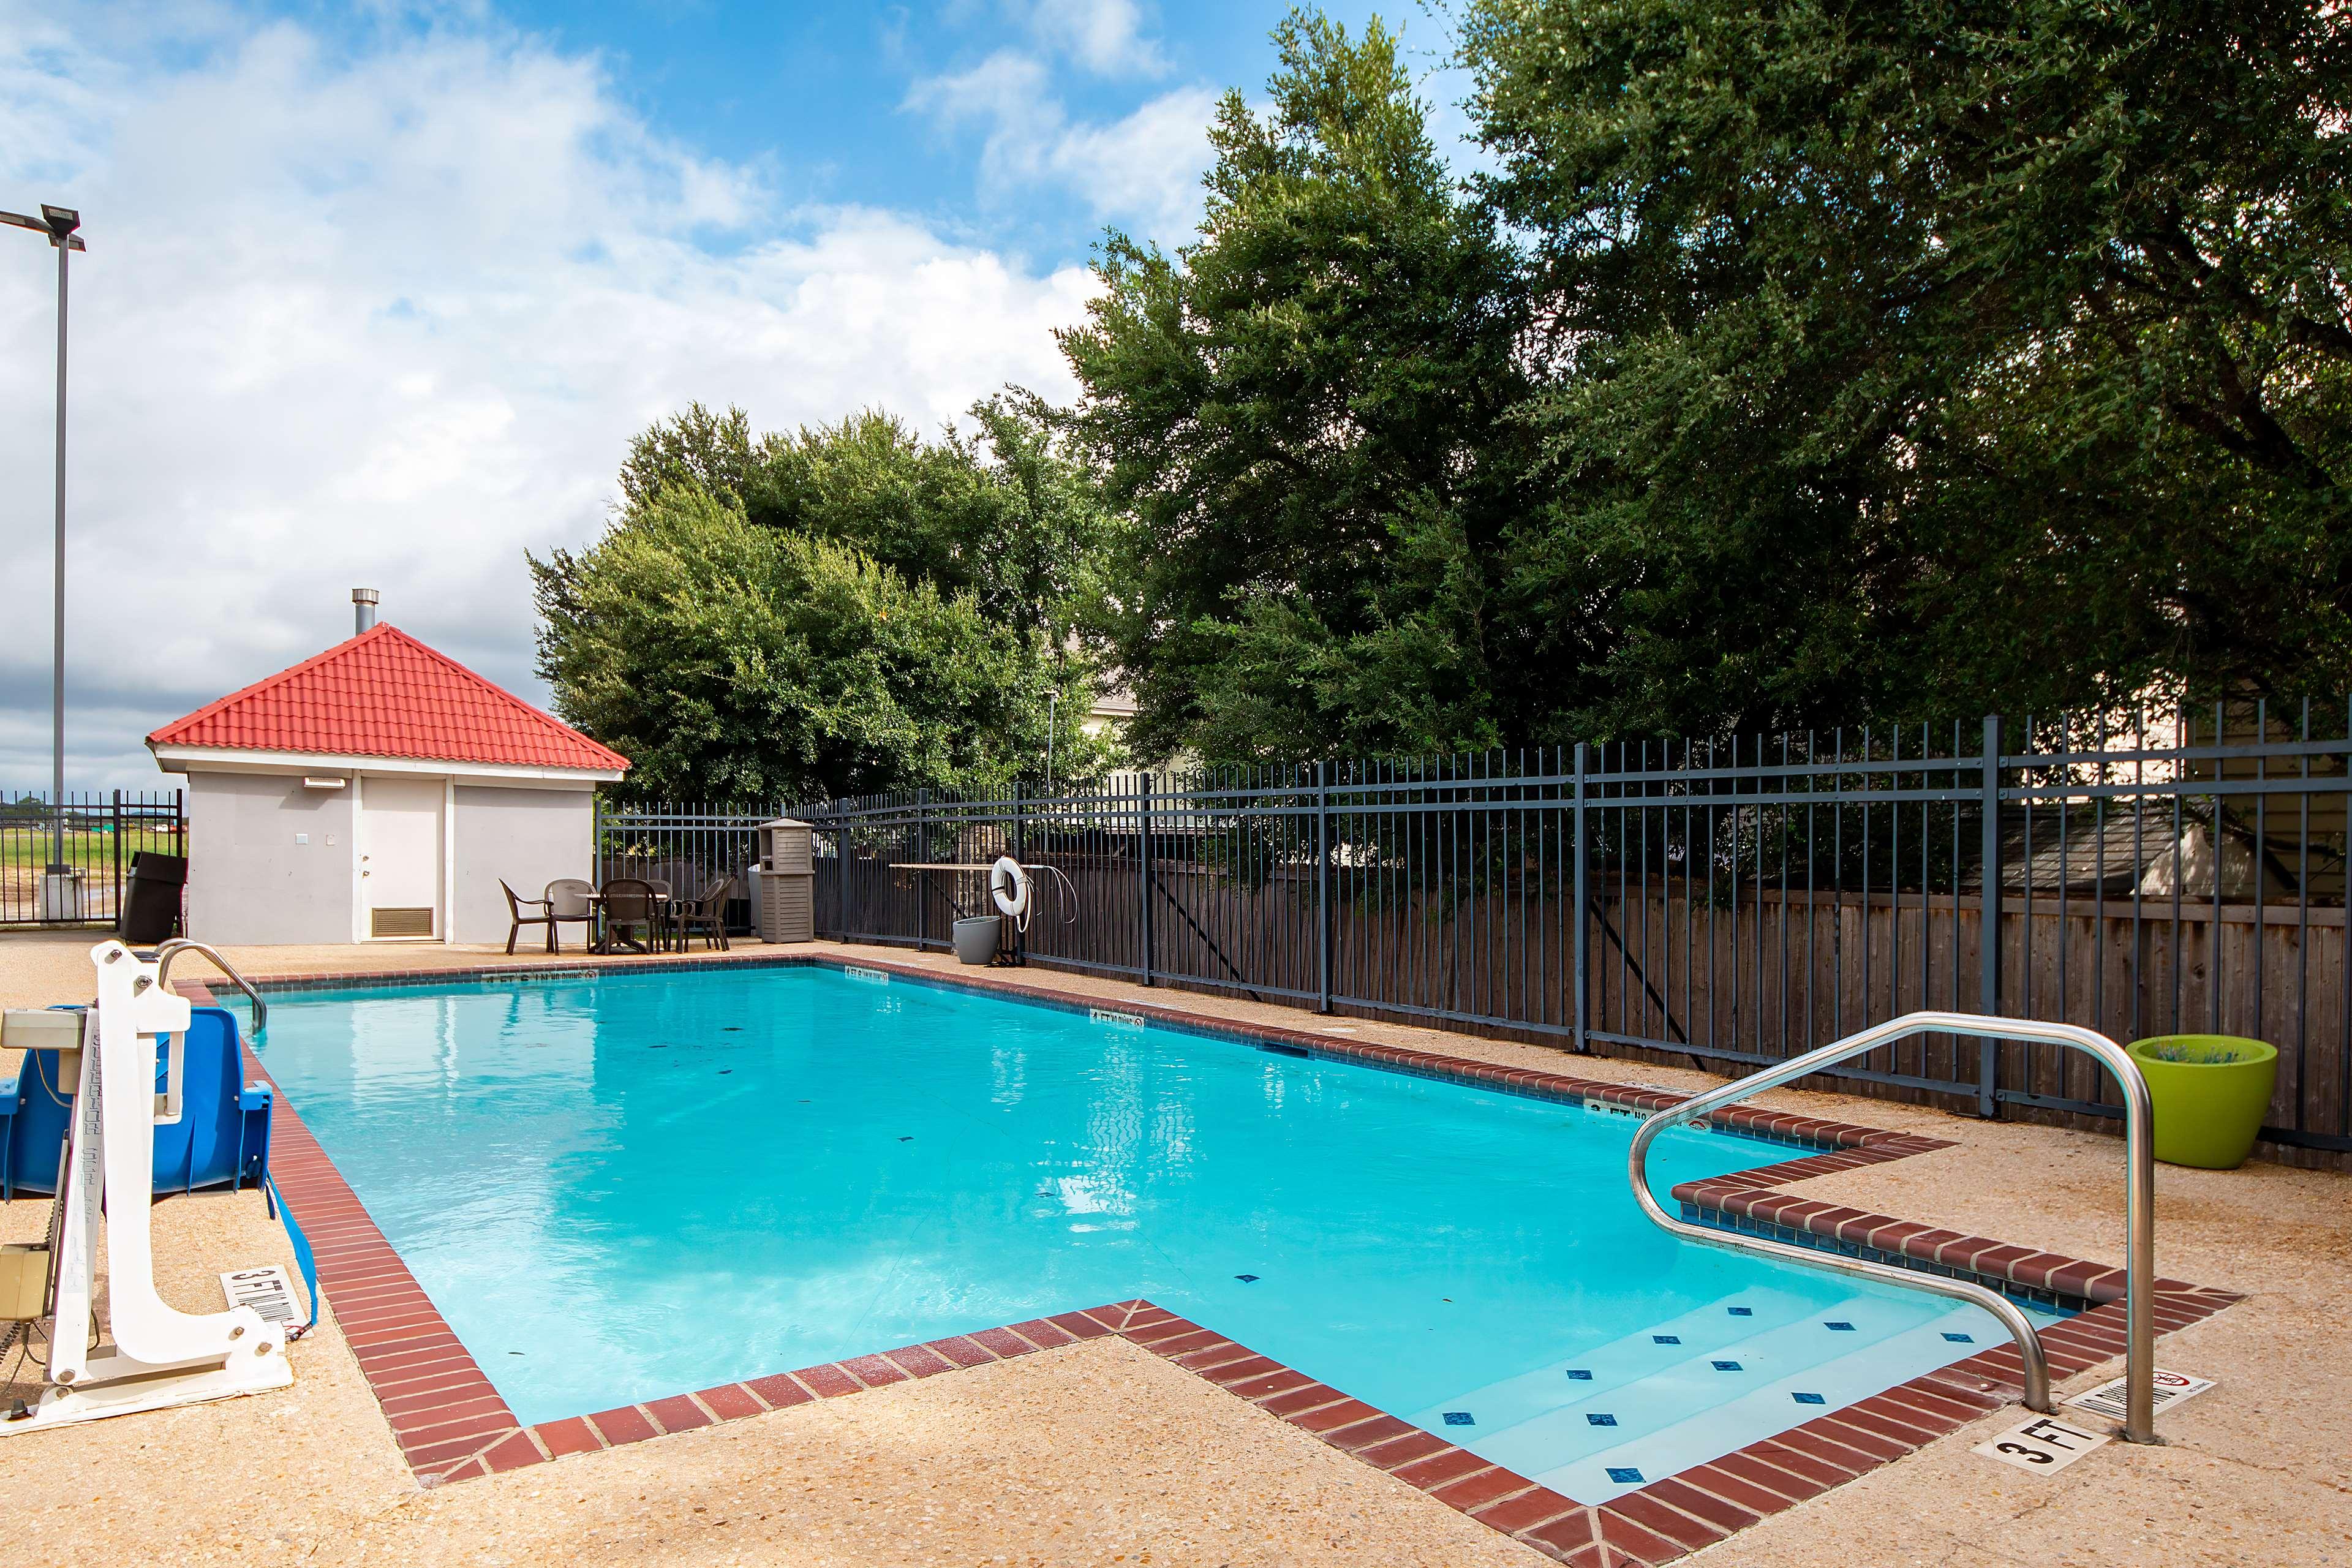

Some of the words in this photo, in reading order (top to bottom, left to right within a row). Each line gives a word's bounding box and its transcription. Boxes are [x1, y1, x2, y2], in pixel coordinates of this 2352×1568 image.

[1634, 1112, 1646, 1120] NO
[232, 1270, 276, 1280] 3
[233, 1280, 283, 1295] FT
[2019, 1419, 2094, 1450] FT
[1996, 1442, 2054, 1464] 3
